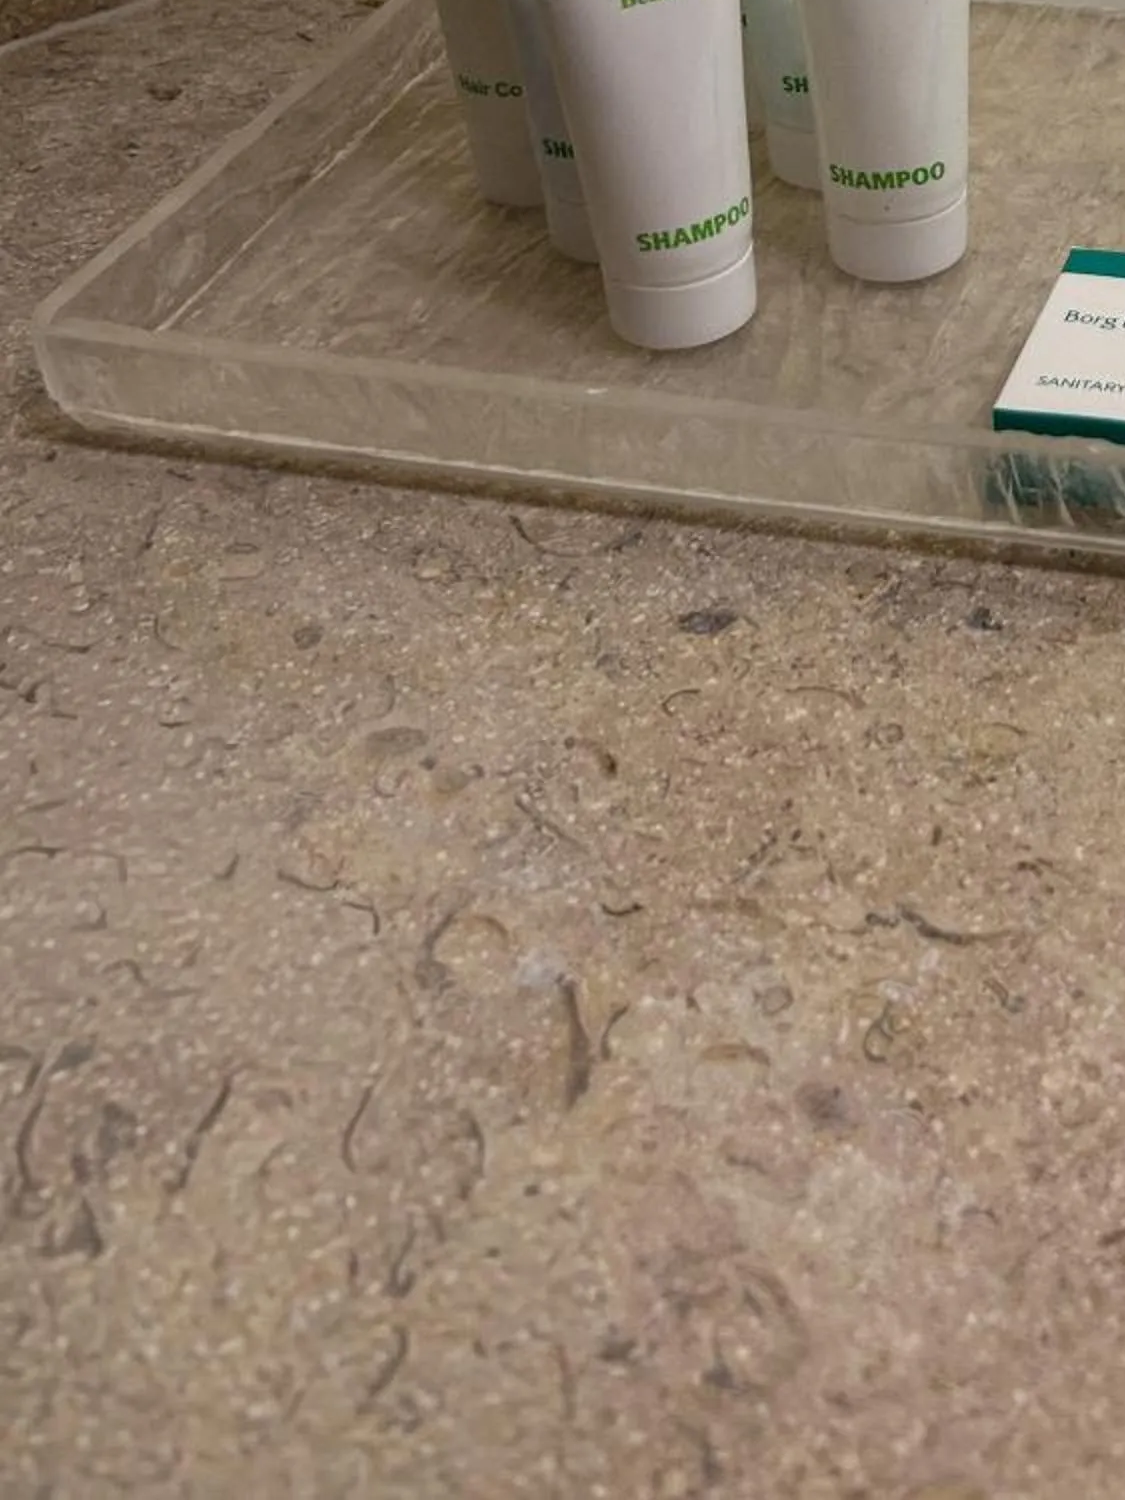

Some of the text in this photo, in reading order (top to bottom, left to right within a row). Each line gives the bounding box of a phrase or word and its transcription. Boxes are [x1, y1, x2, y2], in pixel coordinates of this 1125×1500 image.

[828, 161, 945, 190] SHAMPOO
[635, 196, 749, 252] SHAMPOO
[1063, 309, 1119, 330] Borg
